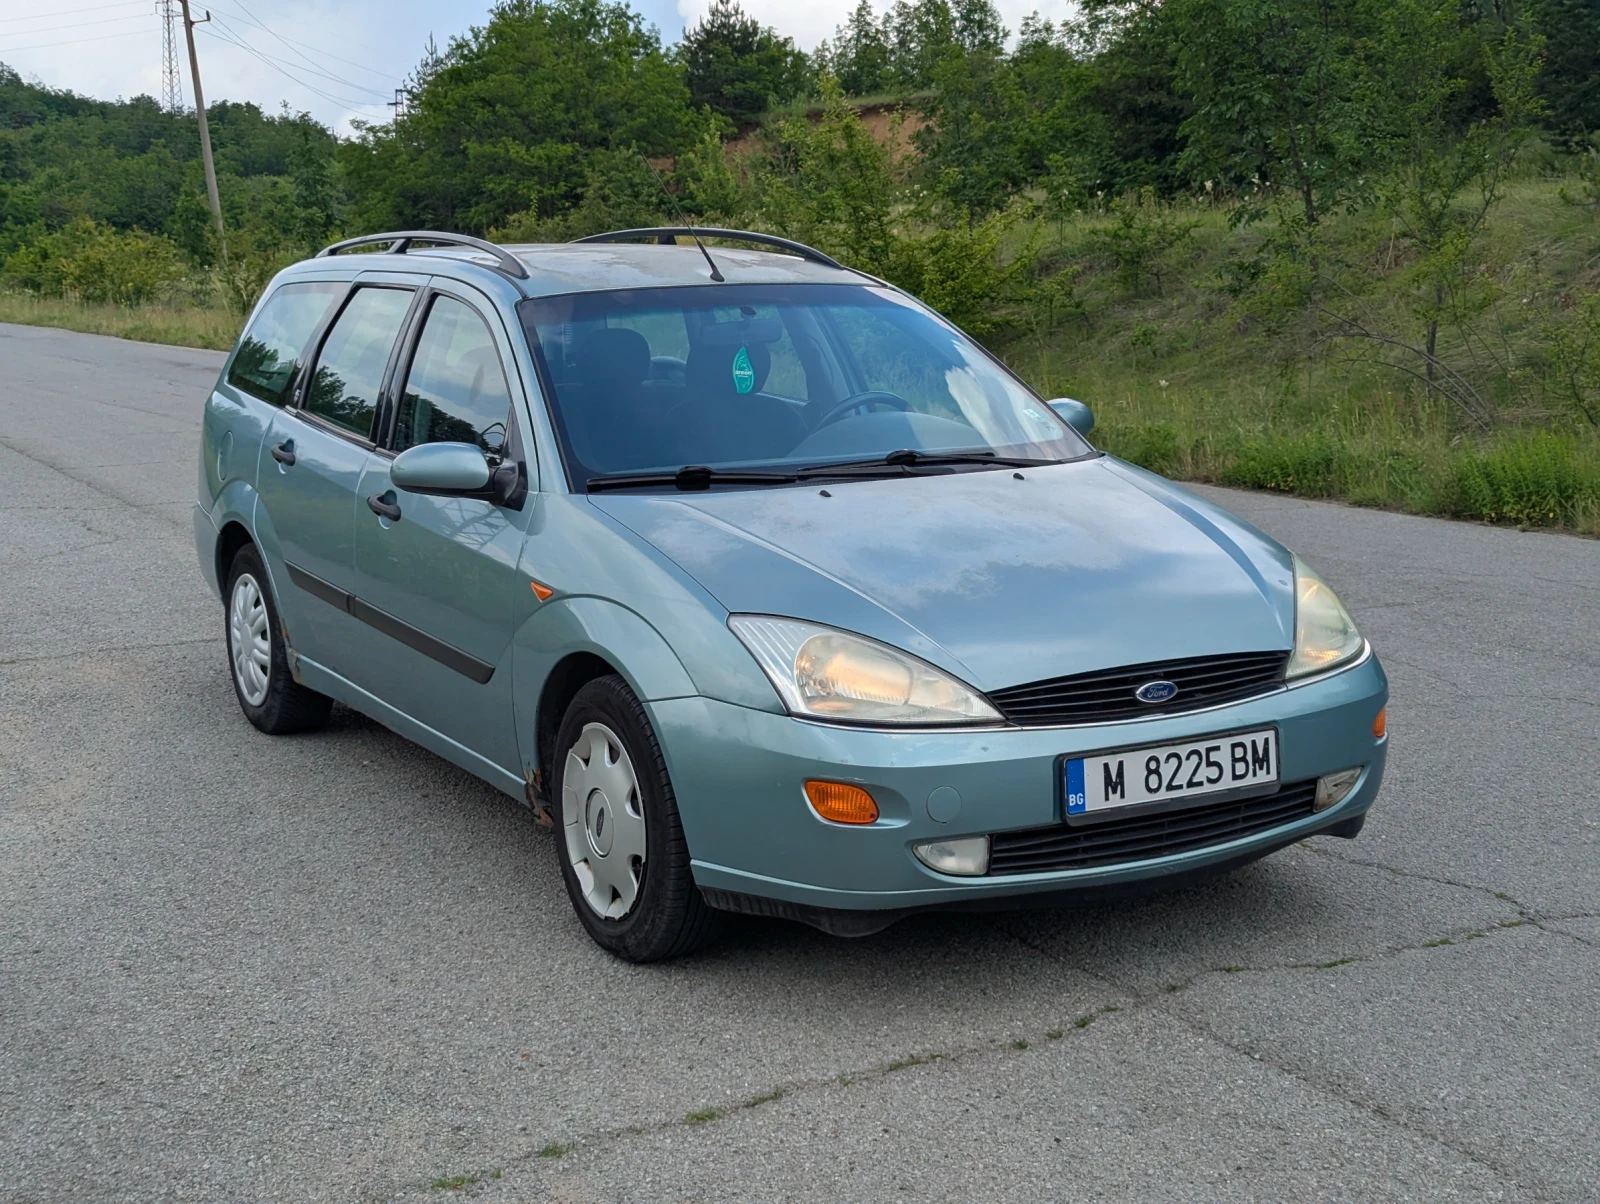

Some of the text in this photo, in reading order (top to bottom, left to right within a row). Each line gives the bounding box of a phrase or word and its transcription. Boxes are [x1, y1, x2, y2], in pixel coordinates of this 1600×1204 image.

[1147, 685, 1169, 698] Ford
[1103, 760, 1125, 801] M
[1069, 793, 1084, 806] BG
